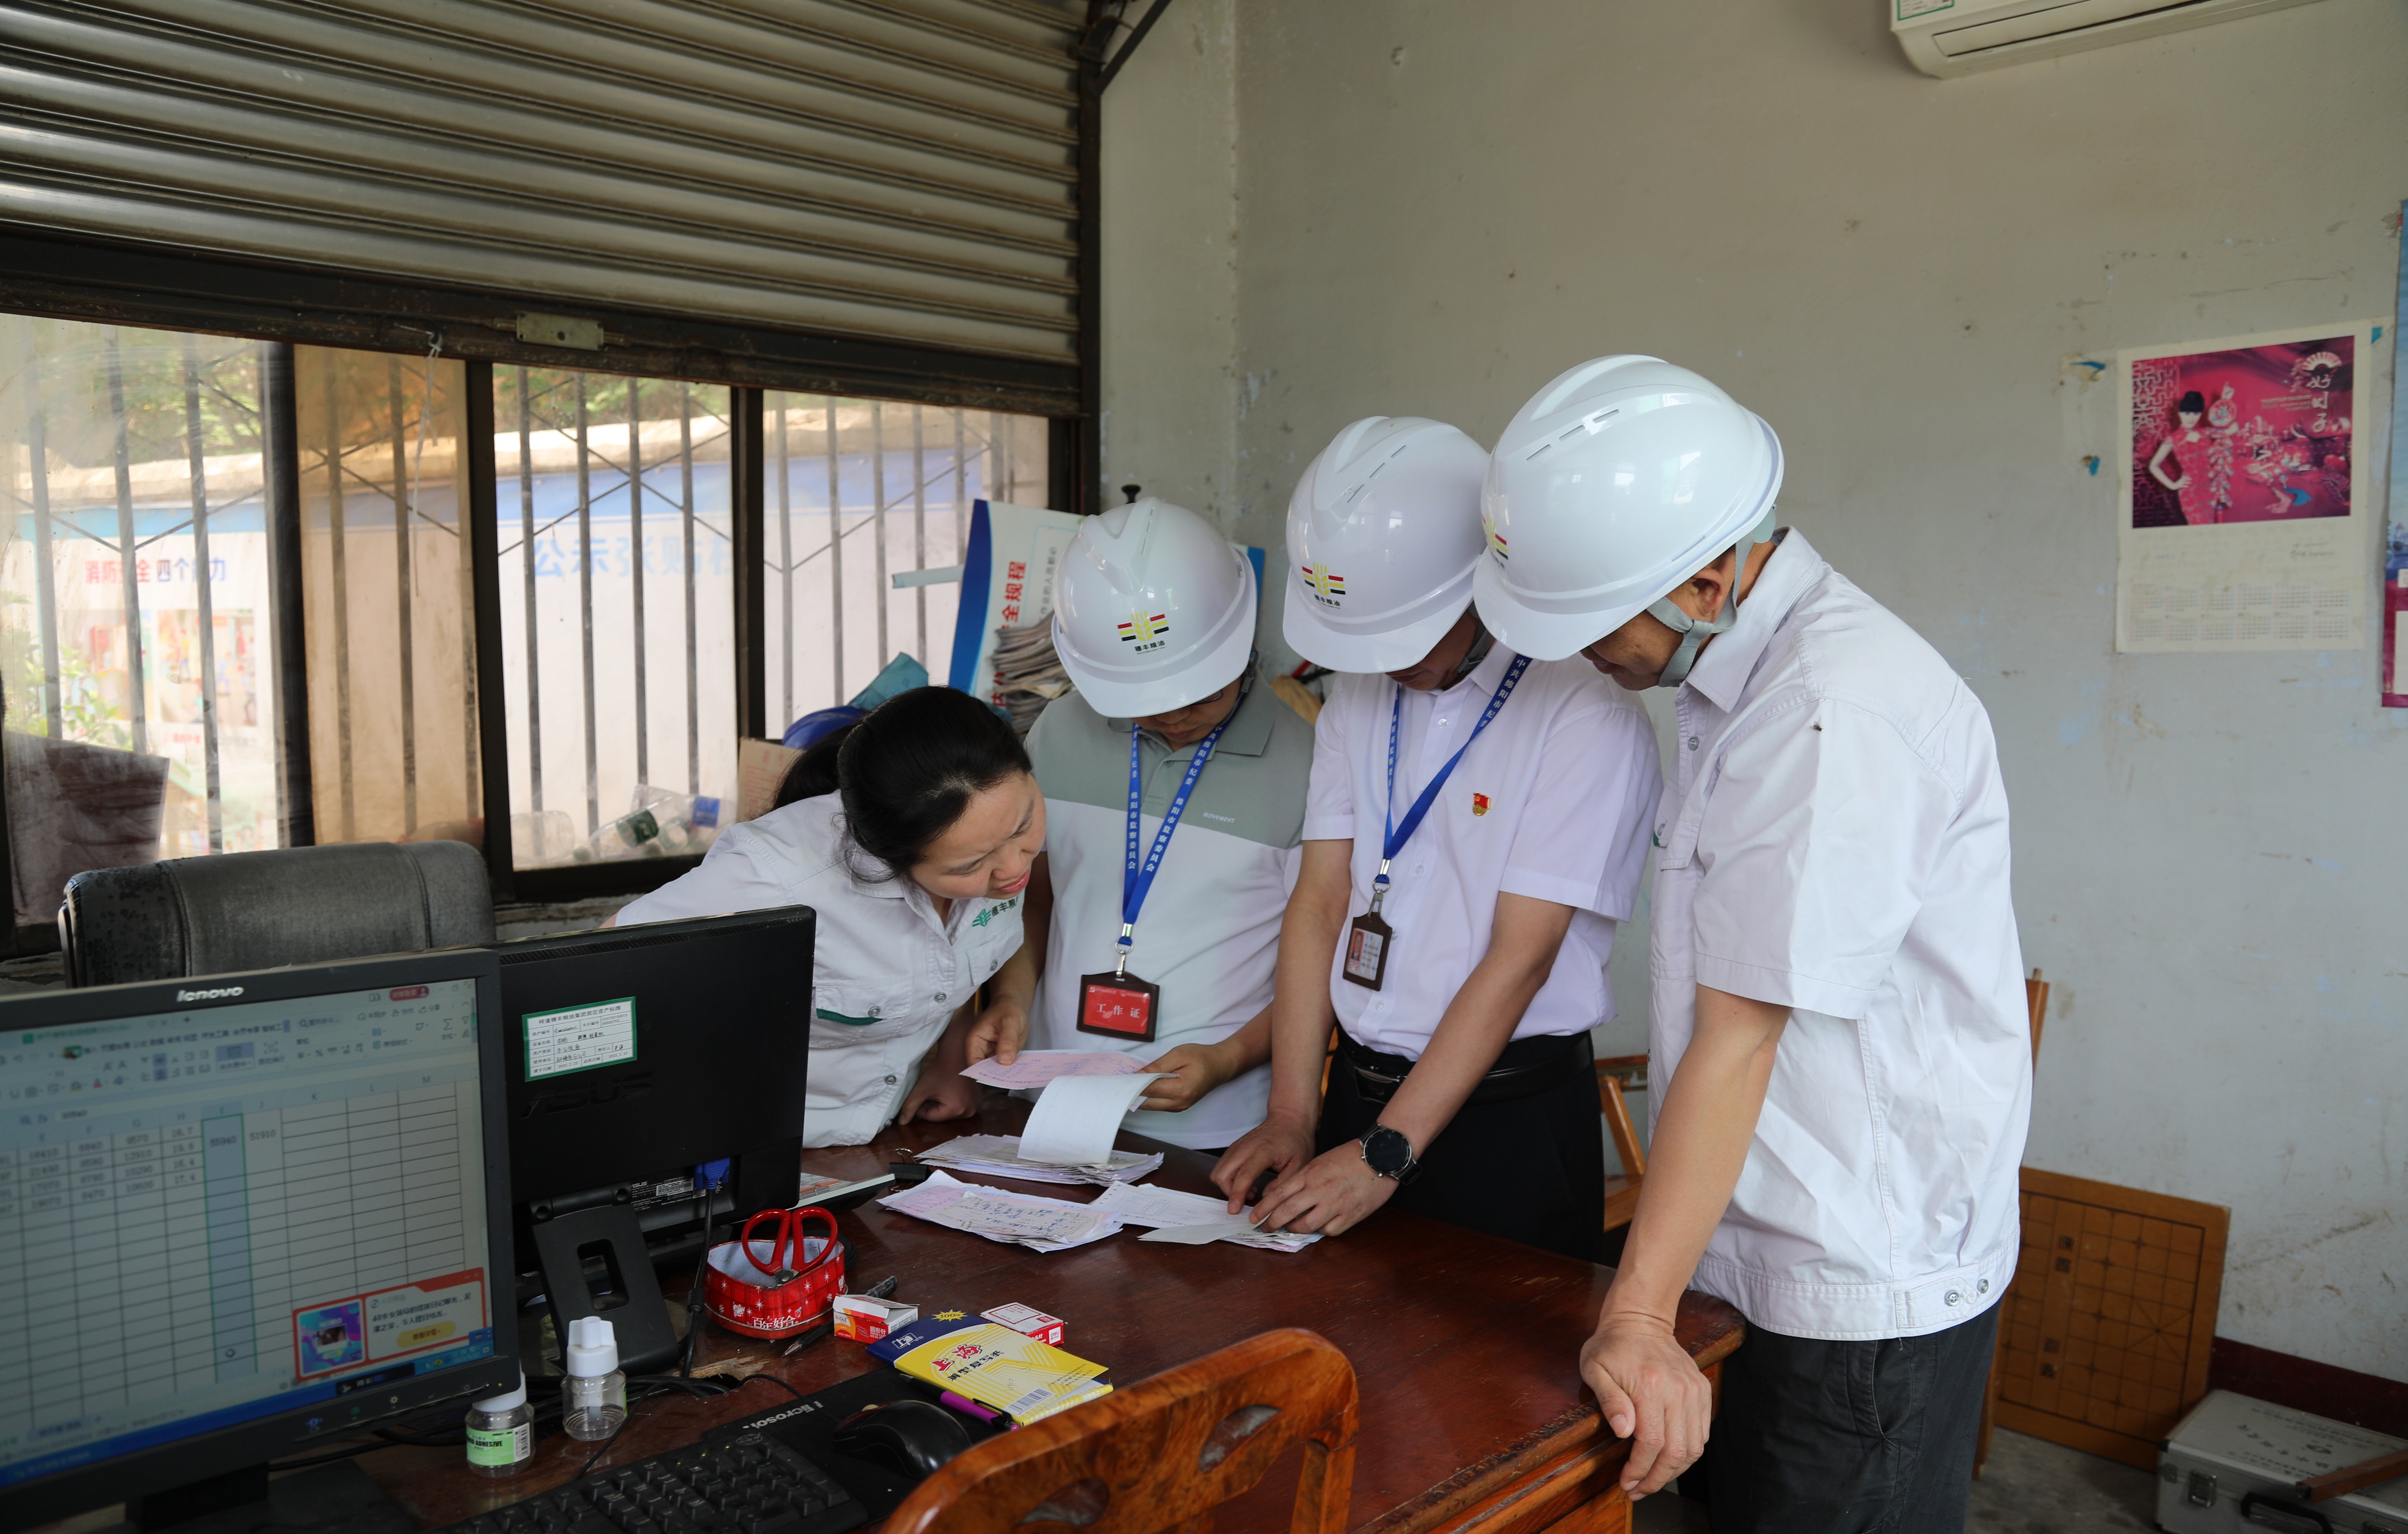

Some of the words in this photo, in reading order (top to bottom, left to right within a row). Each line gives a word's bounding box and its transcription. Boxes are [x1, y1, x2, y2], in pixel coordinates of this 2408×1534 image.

[85, 558, 144, 584] 消防全
[156, 557, 226, 582] 四个力
[1000, 561, 1027, 629] 全规程
[1134, 640, 1165, 652] 穗丰粮油
[1479, 659, 1526, 728] 中共绵阳市纪委
[1128, 792, 1138, 870] 绵阳市监察委员会
[1145, 797, 1185, 872] 绵阳市监察委员会
[991, 896, 1019, 917] 穗丰粮
[176, 986, 245, 1002] lenovo
[752, 1315, 796, 1329] 百年好合
[931, 1344, 982, 1372] 上海
